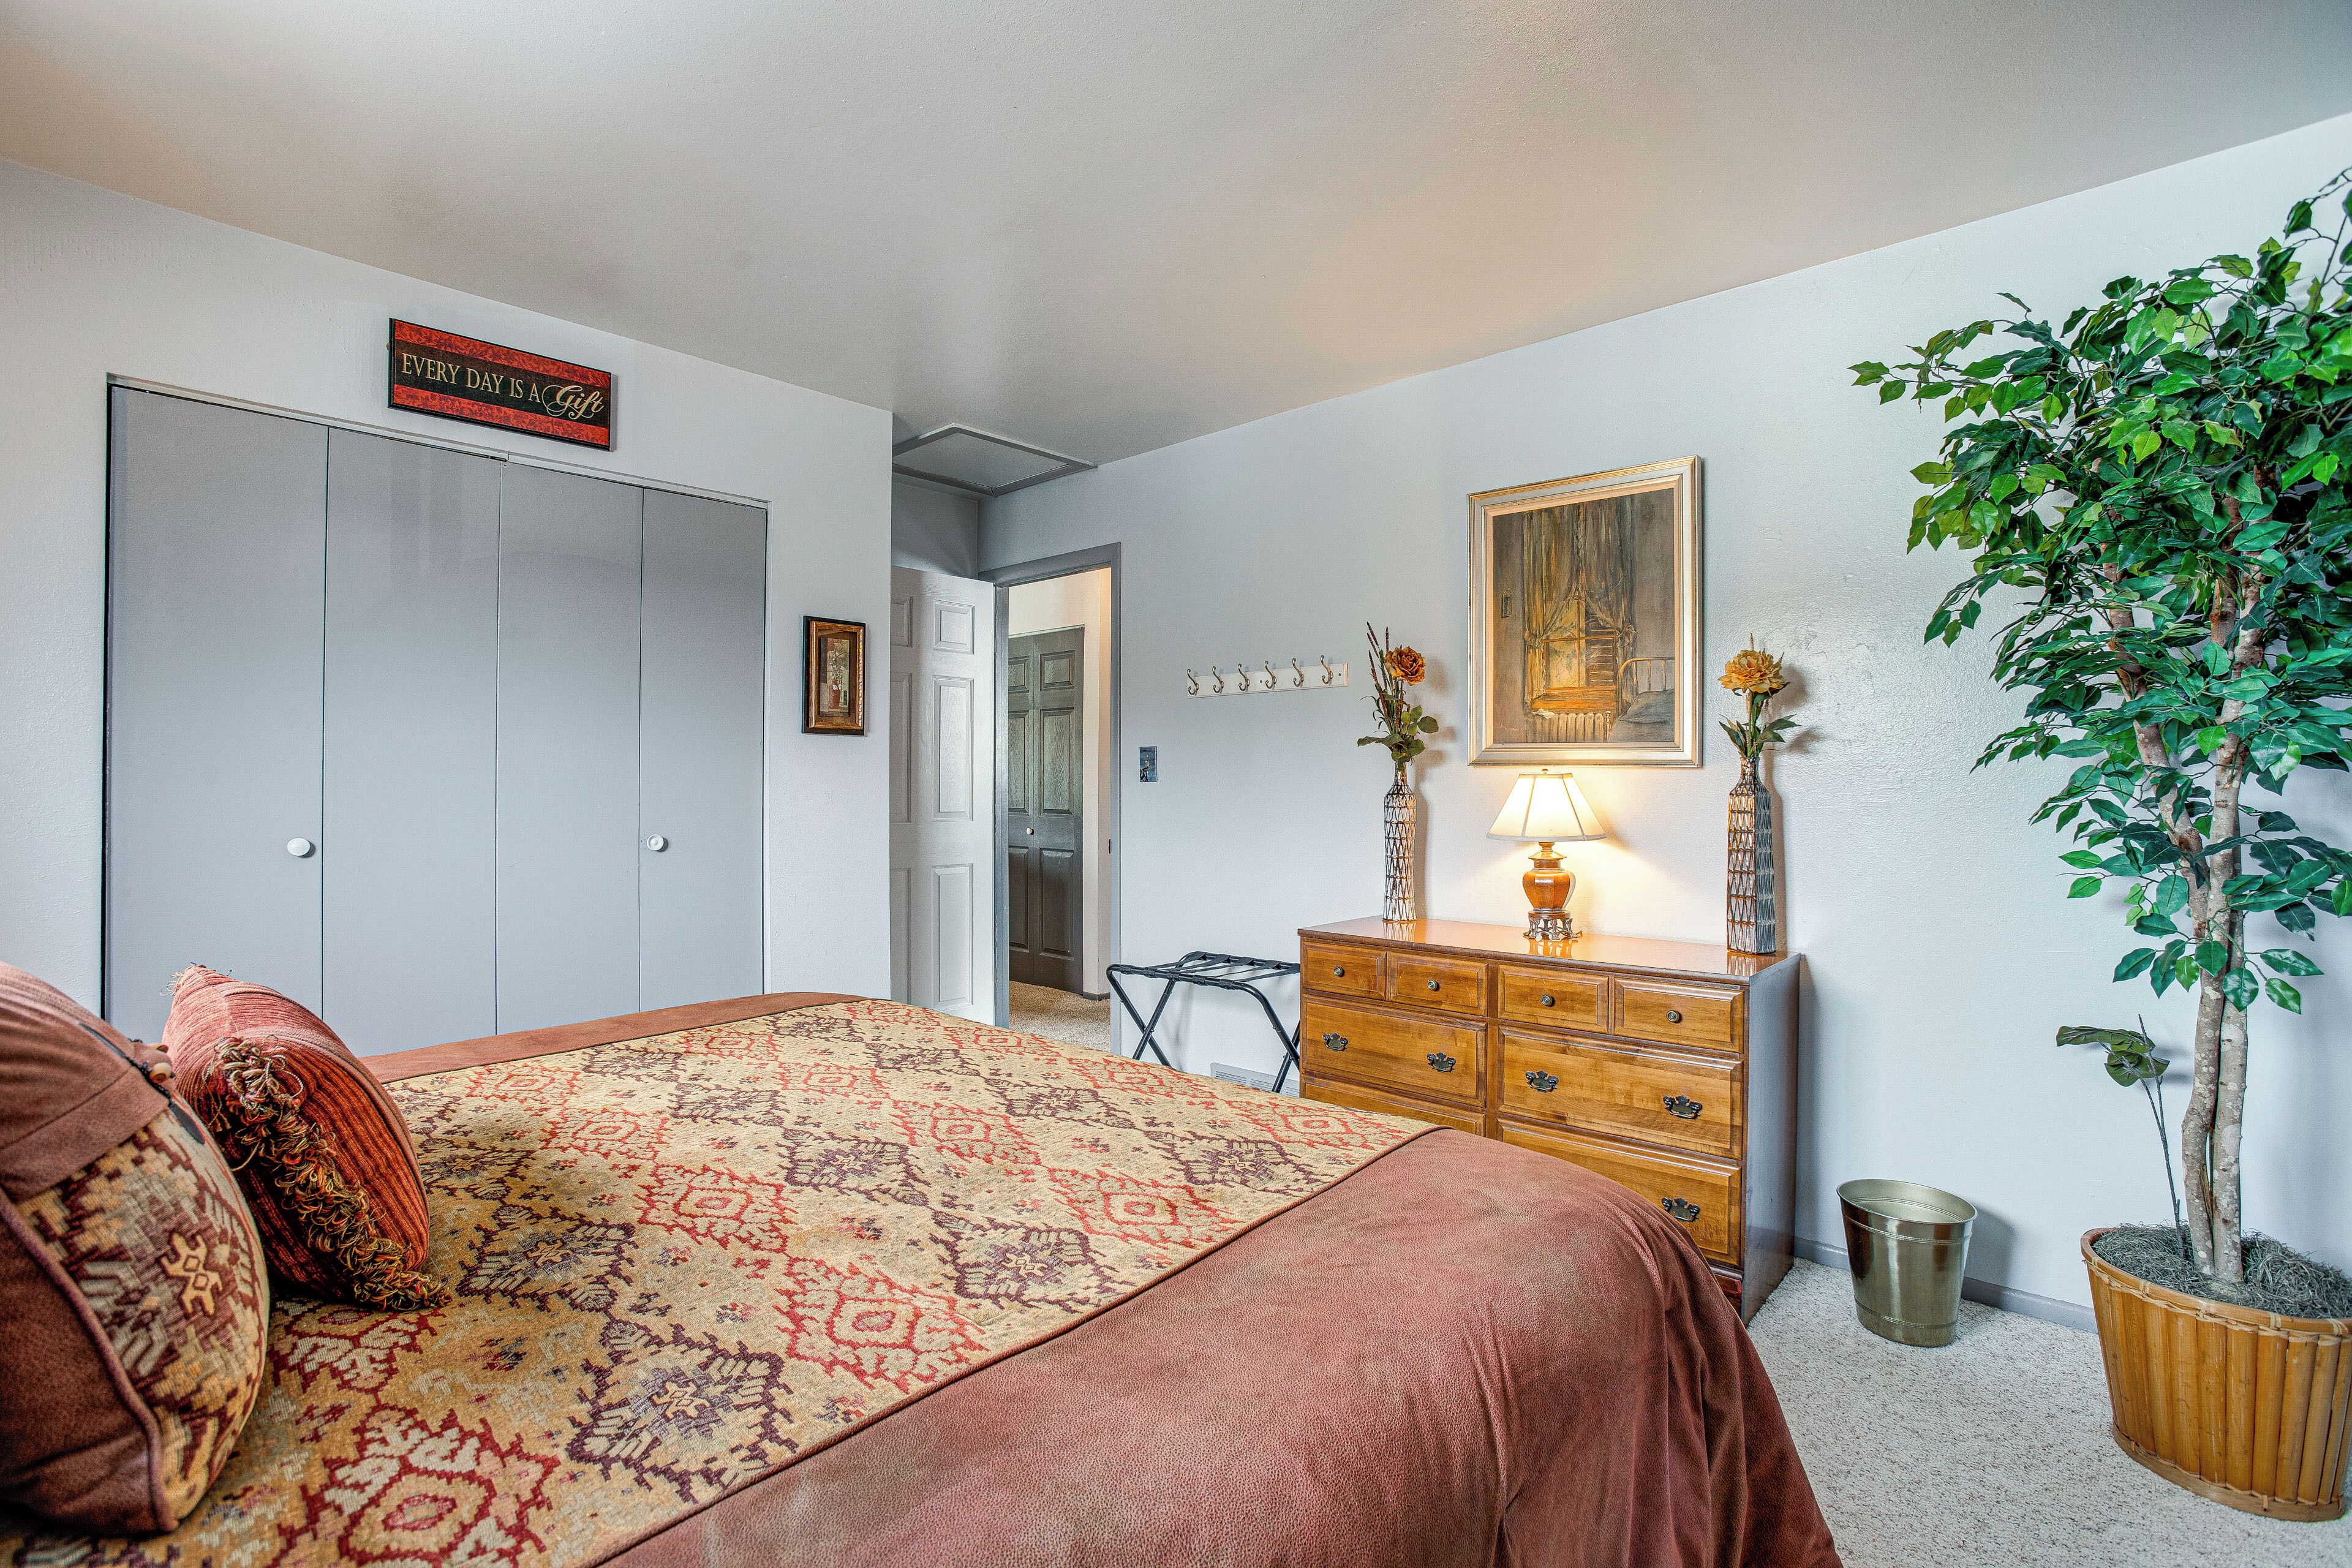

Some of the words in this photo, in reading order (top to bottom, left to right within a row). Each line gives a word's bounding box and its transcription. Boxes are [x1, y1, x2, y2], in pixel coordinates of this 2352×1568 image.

[401, 353, 461, 385] EVERY
[466, 368, 504, 394] DAY
[509, 377, 524, 398] IS
[528, 383, 541, 402] A
[541, 385, 604, 420] Gift
